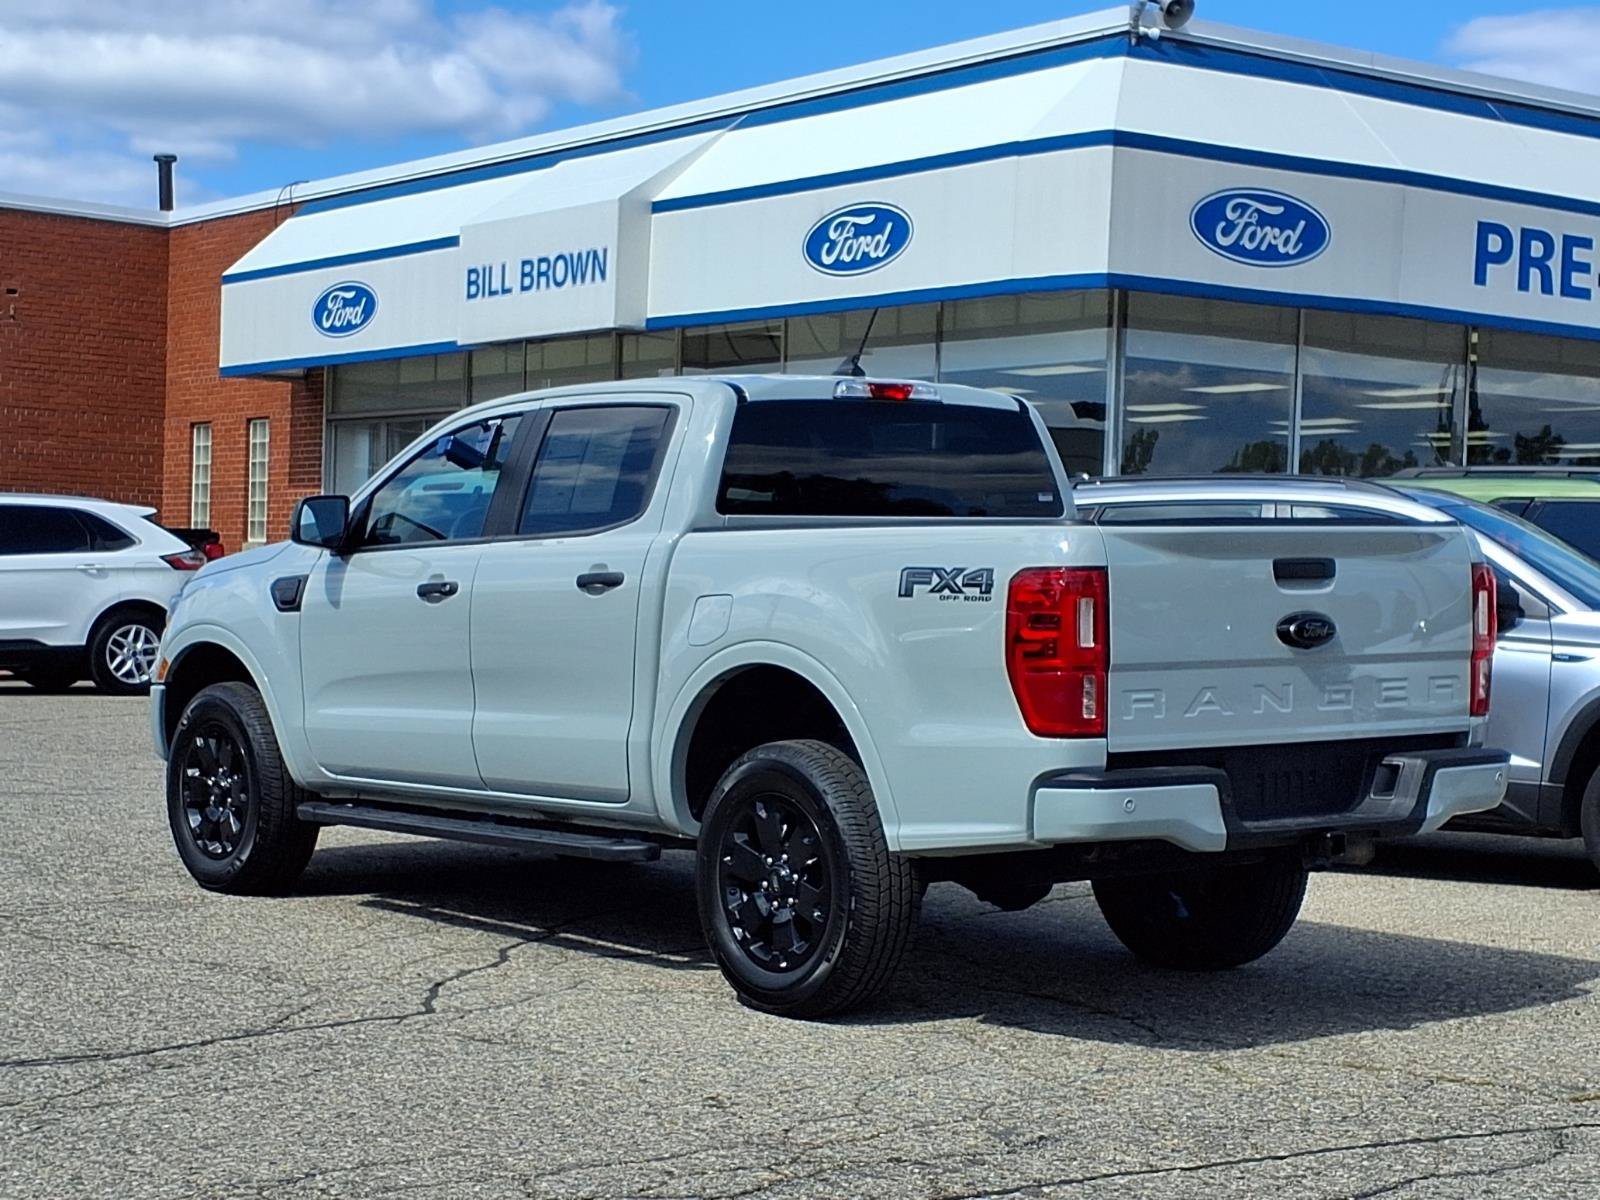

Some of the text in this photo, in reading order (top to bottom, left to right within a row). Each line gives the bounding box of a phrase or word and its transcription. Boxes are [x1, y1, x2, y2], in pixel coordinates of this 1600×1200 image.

[821, 214, 893, 265] Ford
[1215, 198, 1306, 255] Ford
[466, 247, 608, 300] BILL BROWN
[1474, 220, 1600, 301] PRE
[321, 290, 365, 329] Ford
[898, 566, 994, 598] FX4
[939, 594, 992, 602] OFF ROAD
[1122, 674, 1461, 720] RANGER
